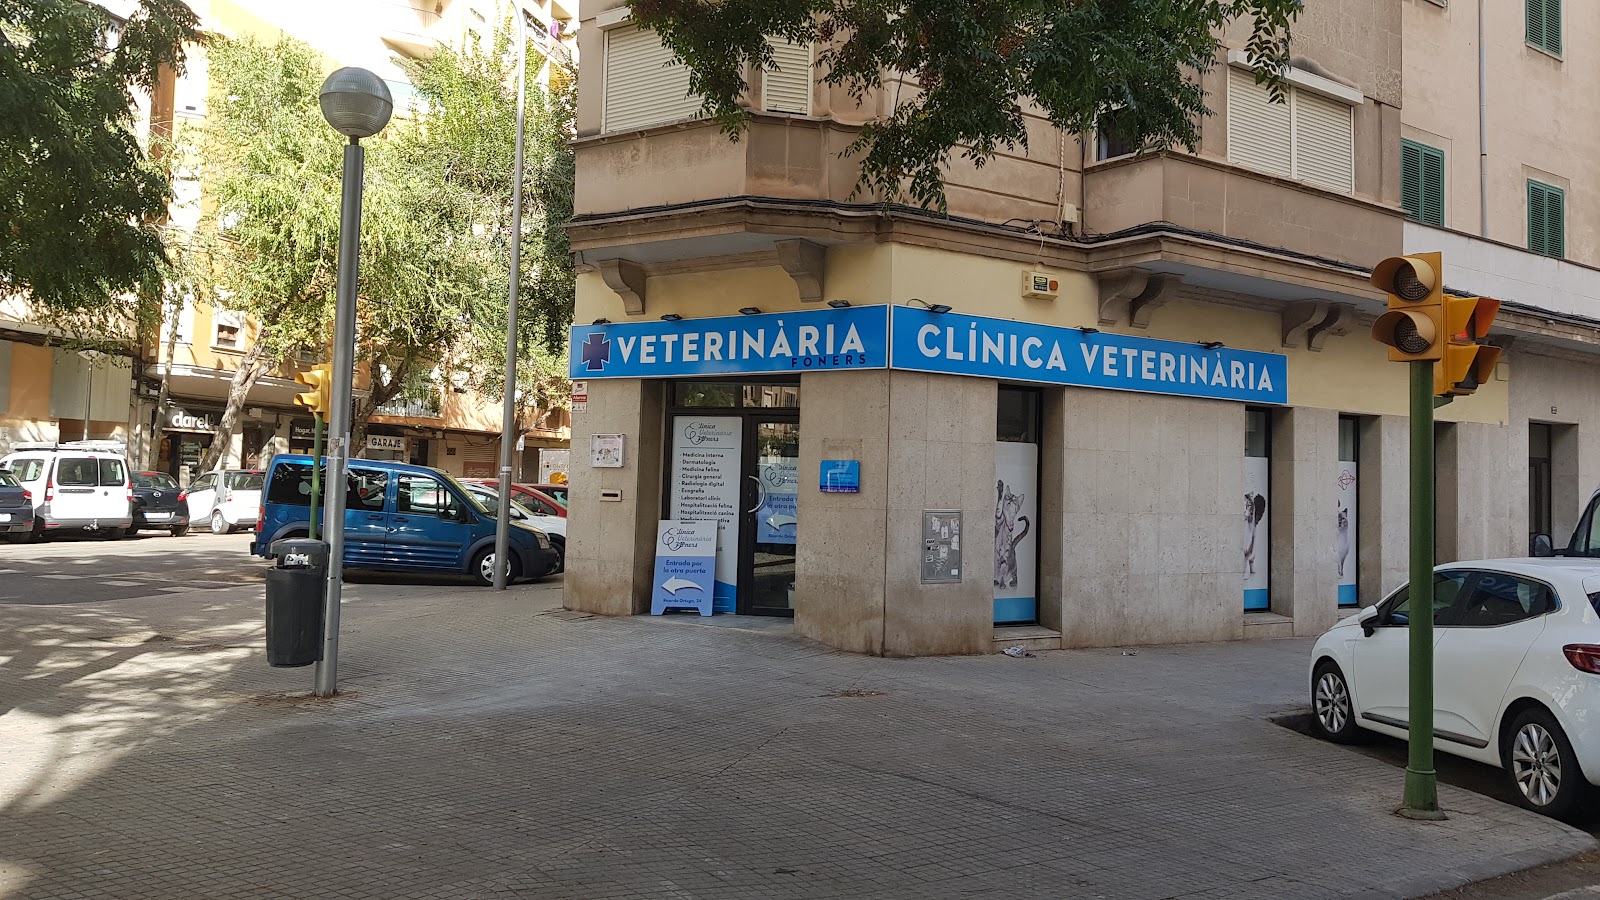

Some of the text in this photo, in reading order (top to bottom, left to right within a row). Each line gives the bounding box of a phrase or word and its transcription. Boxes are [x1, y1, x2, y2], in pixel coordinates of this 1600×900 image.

[617, 320, 866, 365] VETERINÀRIA
[917, 322, 1274, 392] CLÍNICA VETERINÀRIA
[791, 353, 867, 369] FONERS
[371, 438, 401, 448] GARAJE
